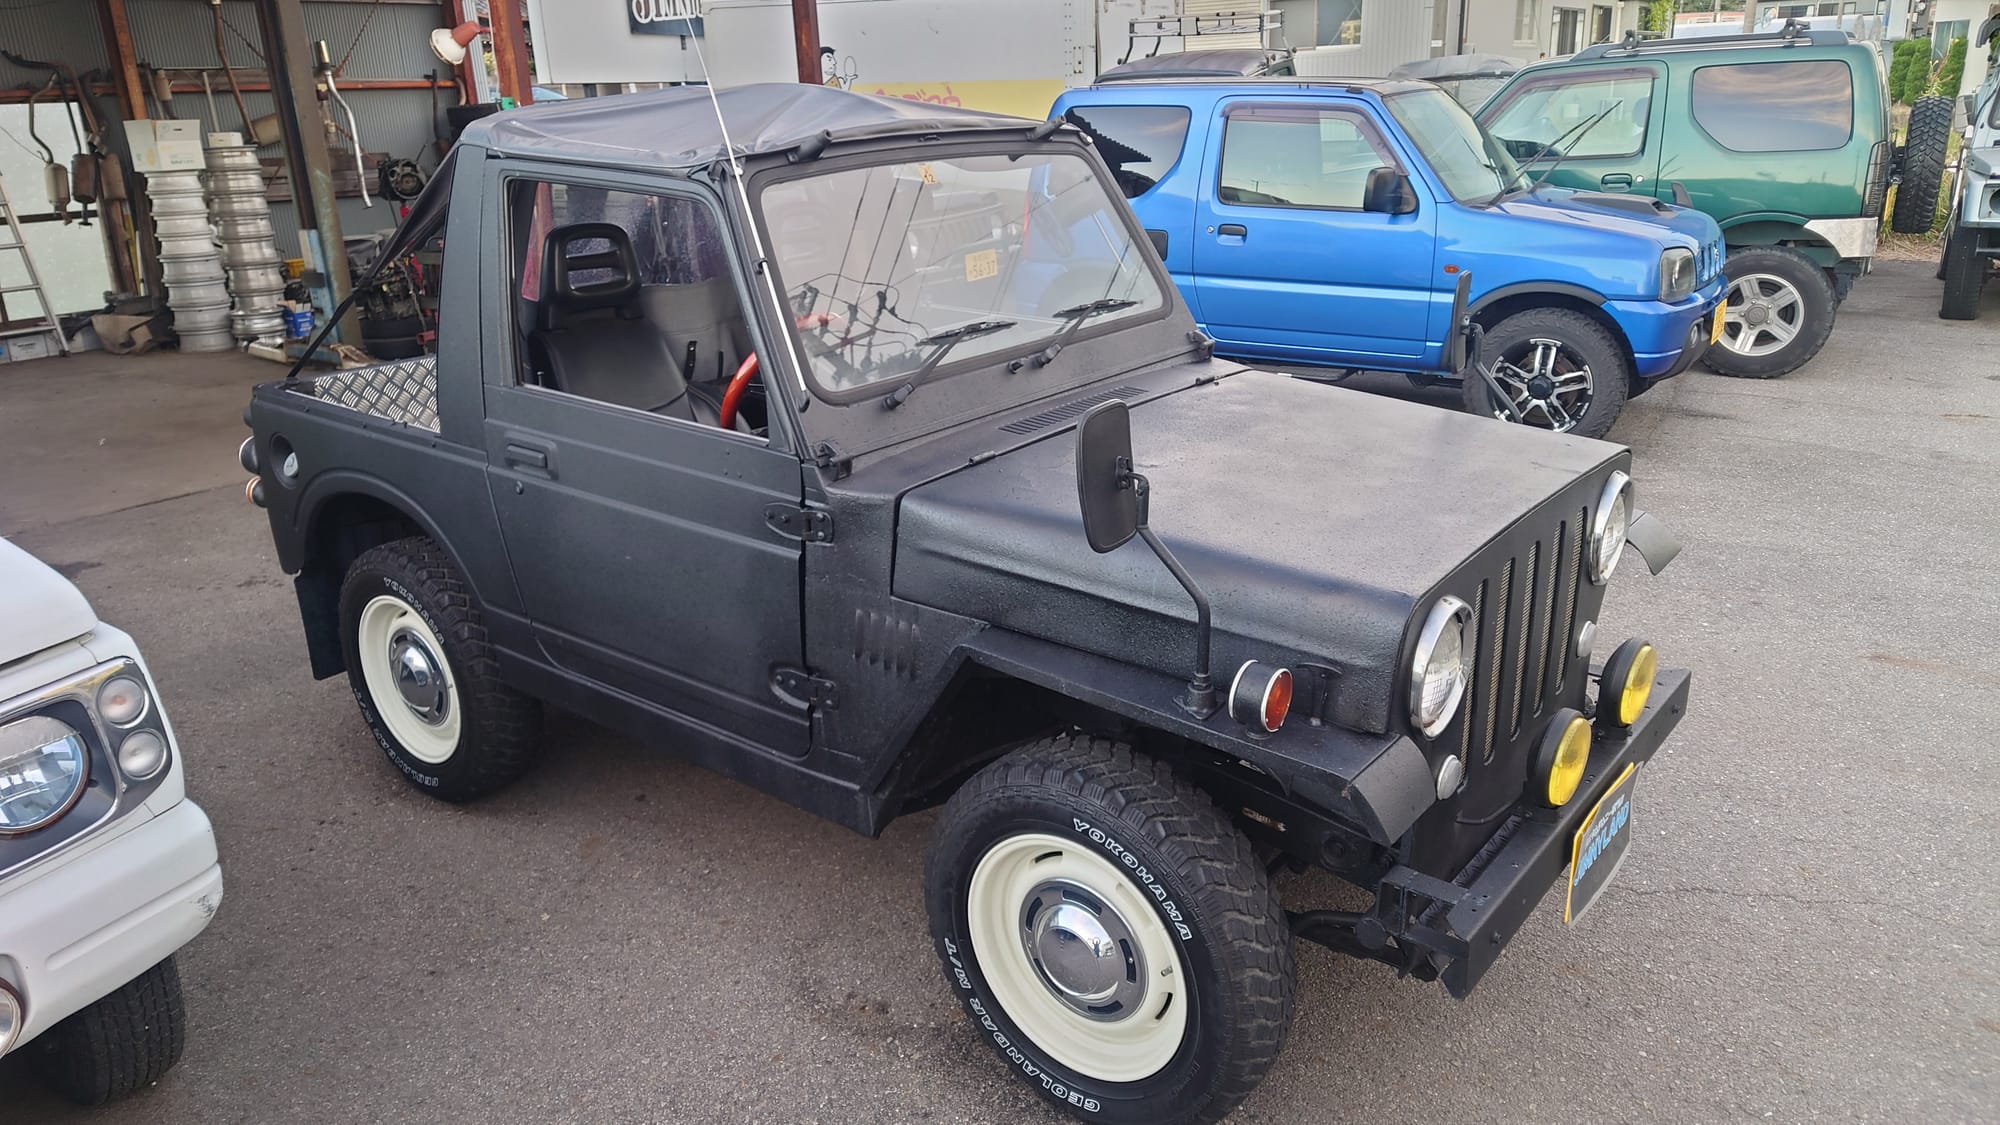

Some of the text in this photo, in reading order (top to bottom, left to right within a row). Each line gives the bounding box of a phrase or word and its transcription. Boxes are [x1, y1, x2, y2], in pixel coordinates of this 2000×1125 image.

[1073, 817, 1193, 941] YOKOHAMA
[944, 937, 1101, 1113] GEOLANDAR M/T
